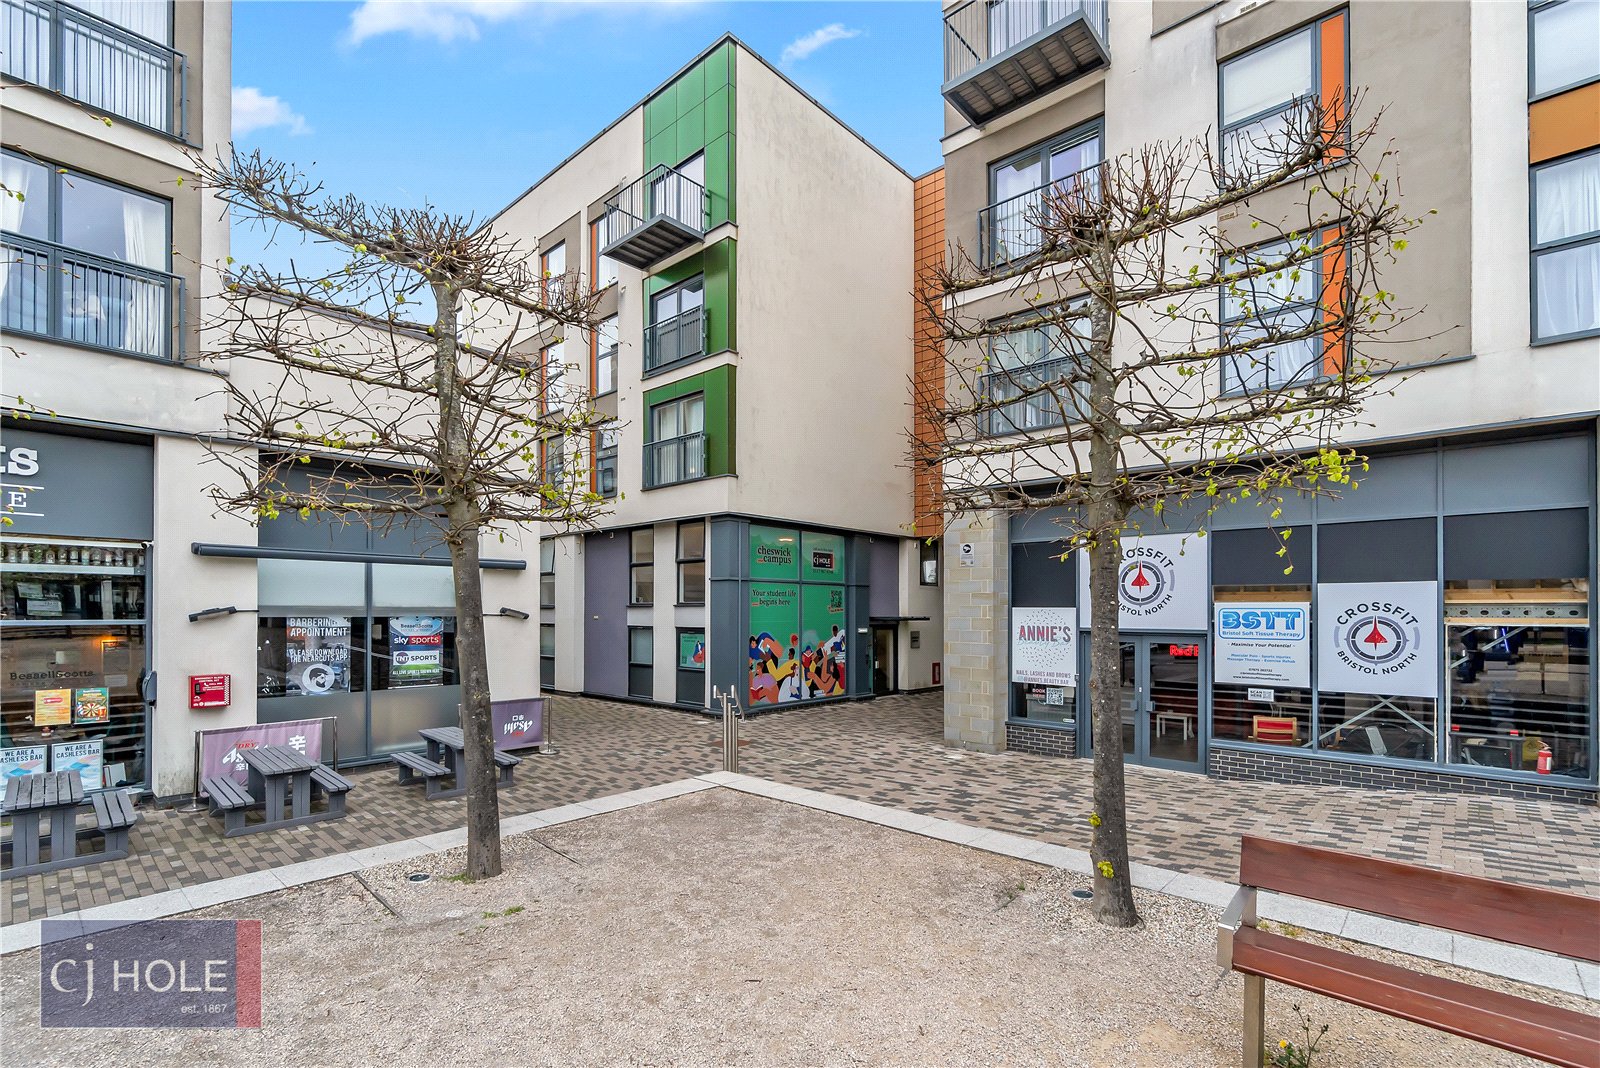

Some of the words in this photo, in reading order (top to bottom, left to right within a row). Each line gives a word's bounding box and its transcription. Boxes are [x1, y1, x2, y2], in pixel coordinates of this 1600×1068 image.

[0, 445, 39, 476] S
[757, 545, 792, 557] cheswick
[763, 555, 792, 565] campus
[1124, 547, 1174, 568] OSSFIT
[752, 589, 766, 597] Your
[759, 598, 778, 607] begins
[1144, 594, 1173, 616] NORTH
[1336, 601, 1419, 625] CROSSFIT
[290, 617, 338, 627] BARBERING
[1222, 611, 1301, 630] BSTT
[290, 627, 348, 637] APPOINTMENT
[1019, 625, 1071, 642] ANNIE'S
[393, 636, 409, 645] sky
[411, 635, 439, 645] sports
[314, 648, 348, 656] DOWNLOAD
[1169, 644, 1192, 657] Red
[1337, 650, 1378, 675] BRISTOL
[1381, 652, 1418, 675] NORTH
[503, 720, 533, 735] Asahi
[0, 755, 29, 764] ASHLESS
[56, 750, 87, 759] CASHLESS
